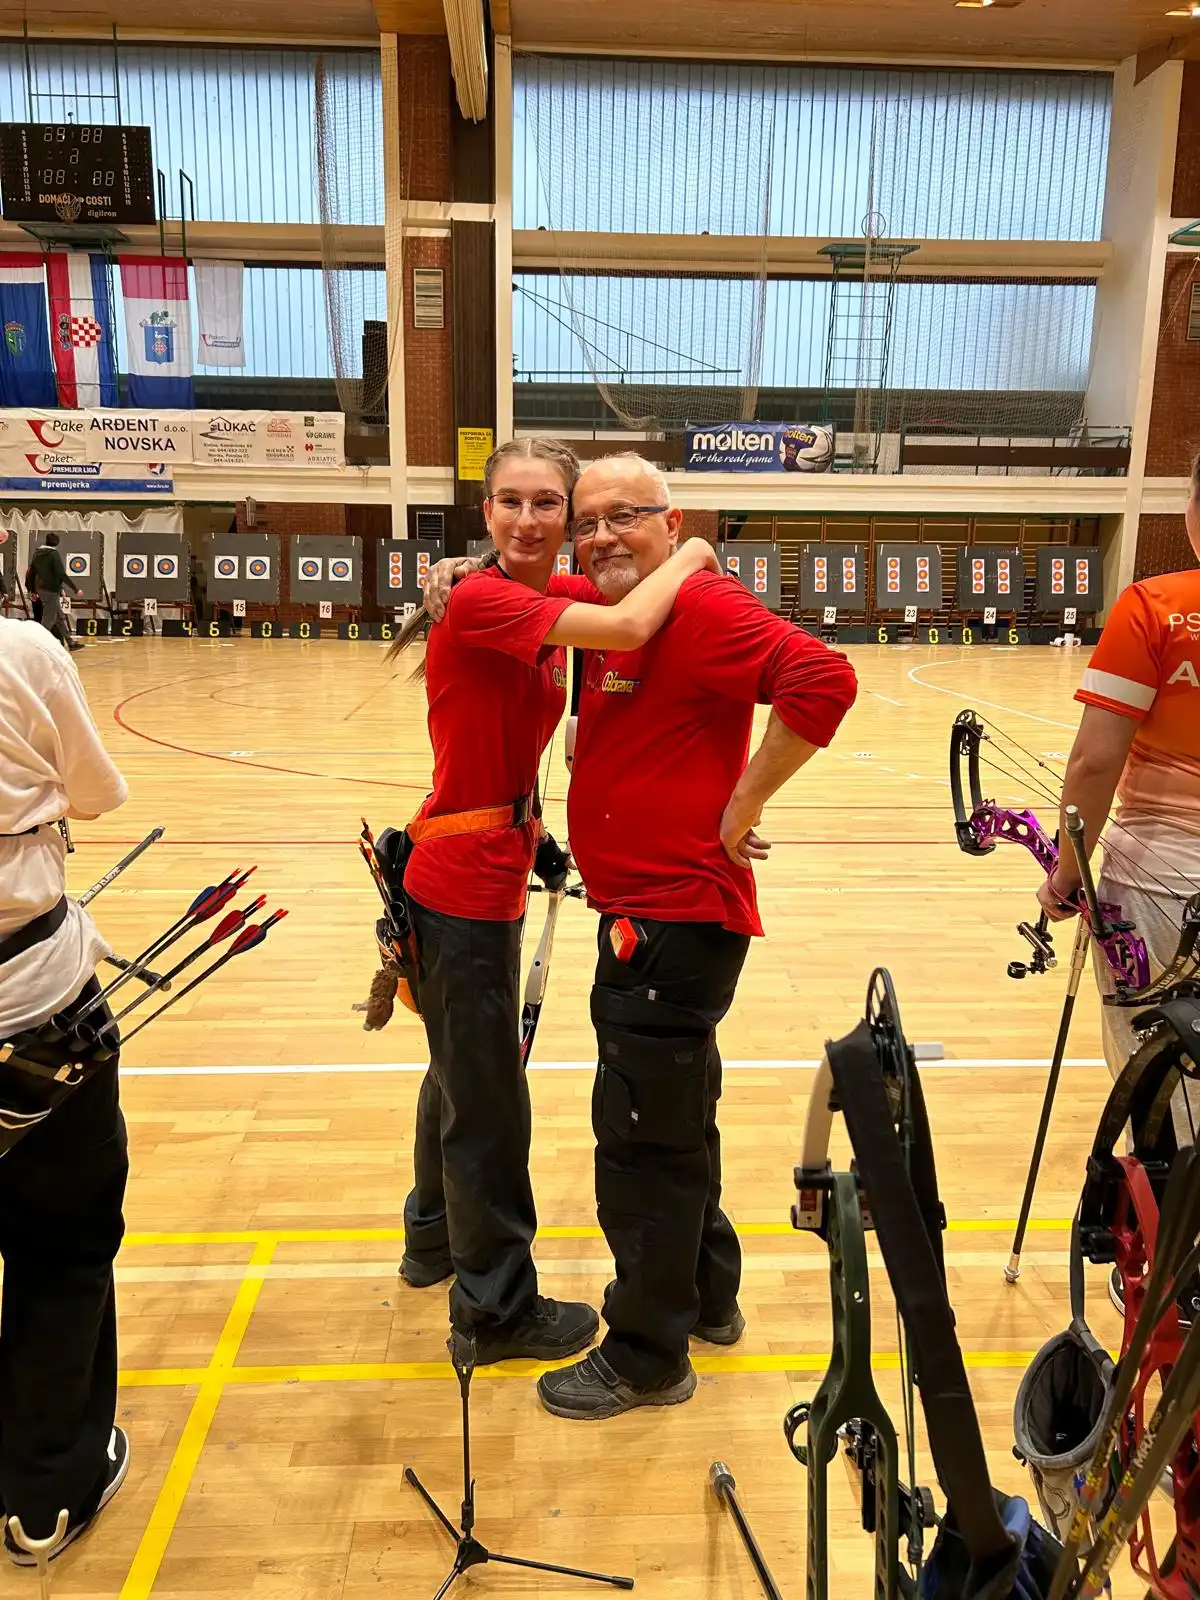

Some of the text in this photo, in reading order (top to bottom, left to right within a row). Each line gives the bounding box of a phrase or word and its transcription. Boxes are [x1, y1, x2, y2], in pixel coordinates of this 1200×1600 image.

[52, 420, 84, 432] Pake
[90, 418, 188, 432] ARĐENT d.o.o.
[217, 420, 256, 432] LUKAČ
[104, 437, 176, 451] NOVSKA
[692, 430, 774, 451] molten
[690, 452, 774, 466] For the real game
[41, 481, 90, 489] #premijerka
[235, 604, 244, 612] 15
[321, 605, 330, 613] 16
[826, 610, 835, 618] 22
[986, 611, 995, 619] 24
[1066, 612, 1075, 620] 25
[87, 620, 97, 636] 0
[122, 620, 132, 635] 2
[182, 622, 192, 636] 4
[209, 622, 219, 636] 6
[262, 622, 272, 637] 0
[300, 623, 310, 638] 0
[348, 624, 358, 638] 0
[382, 624, 392, 639] 6
[878, 627, 888, 643] 6
[929, 629, 938, 644] 0
[962, 628, 972, 644] 0
[1009, 629, 1018, 644] 6
